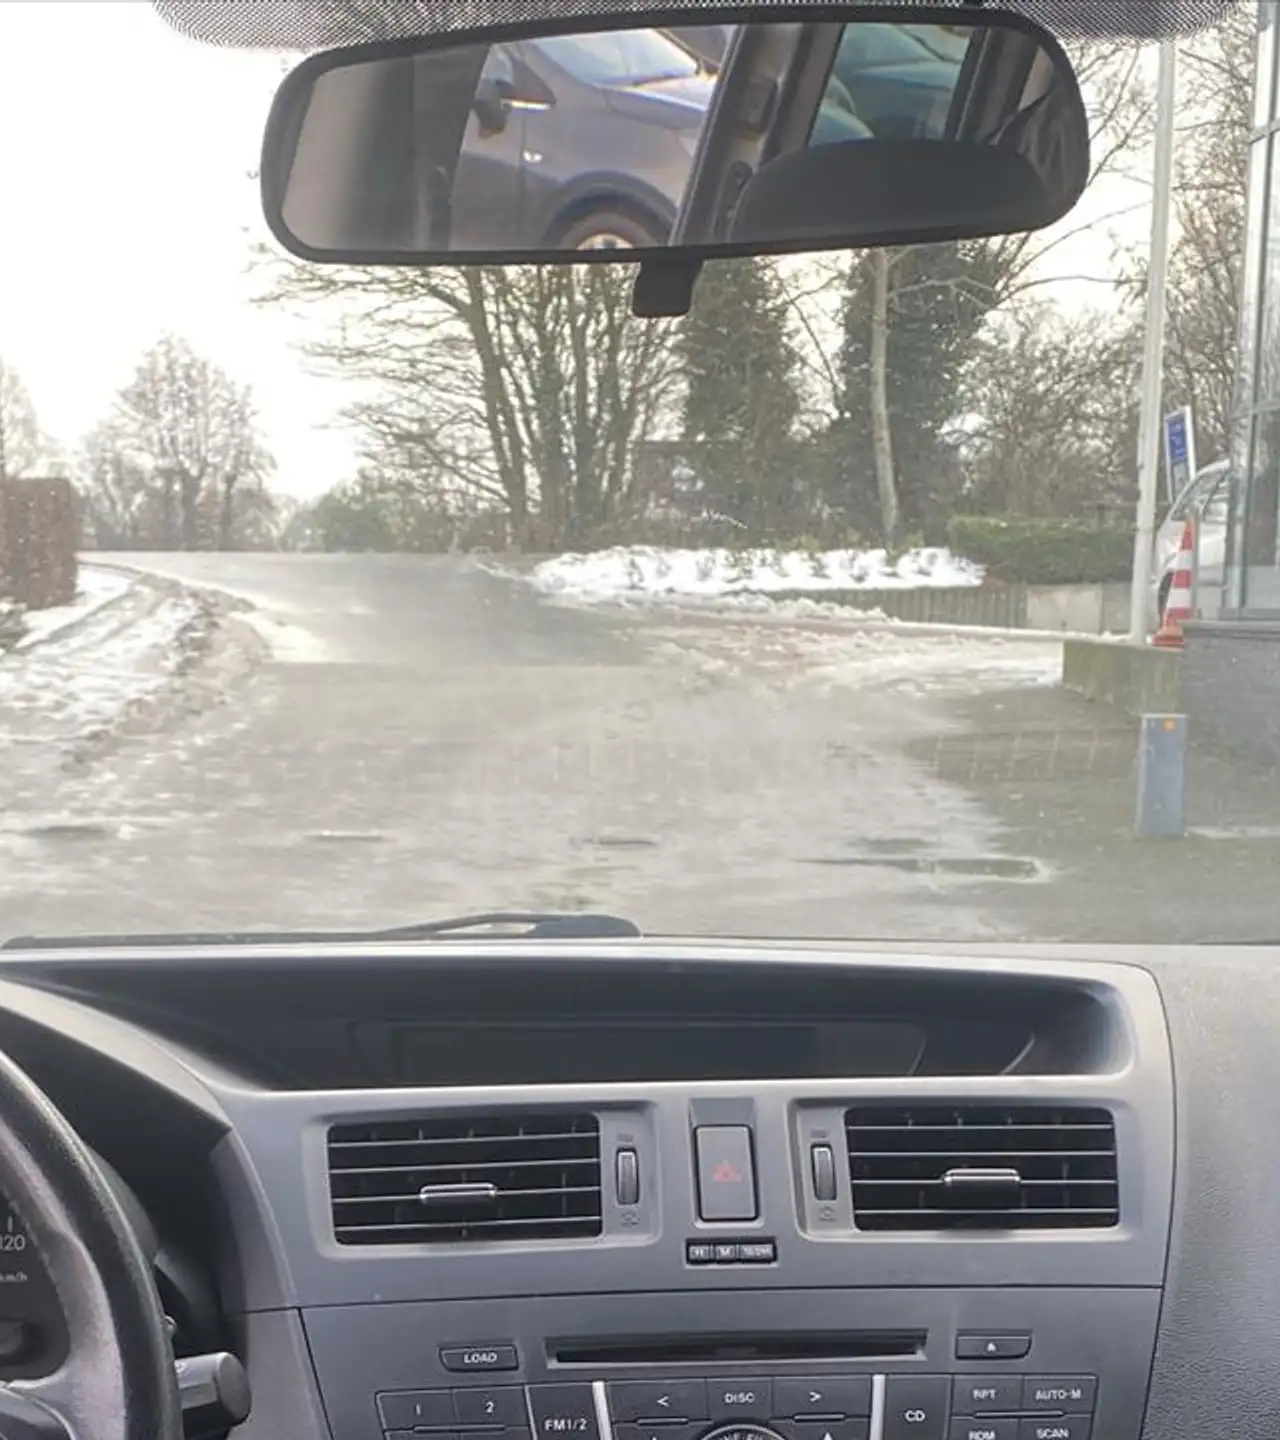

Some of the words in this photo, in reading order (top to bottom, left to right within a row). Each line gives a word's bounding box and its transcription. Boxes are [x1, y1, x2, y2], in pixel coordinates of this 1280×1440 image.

[464, 1352, 498, 1364] LOAD
[724, 1392, 755, 1403] DISC
[973, 1389, 996, 1399] RPT
[1035, 1389, 1081, 1400] AUTO-M
[416, 1404, 421, 1415] 1
[486, 1402, 495, 1413] 2
[904, 1410, 925, 1422] CD
[545, 1418, 588, 1431] FM1/2
[969, 1431, 996, 1440] RDM
[1036, 1428, 1069, 1439] SCAN
